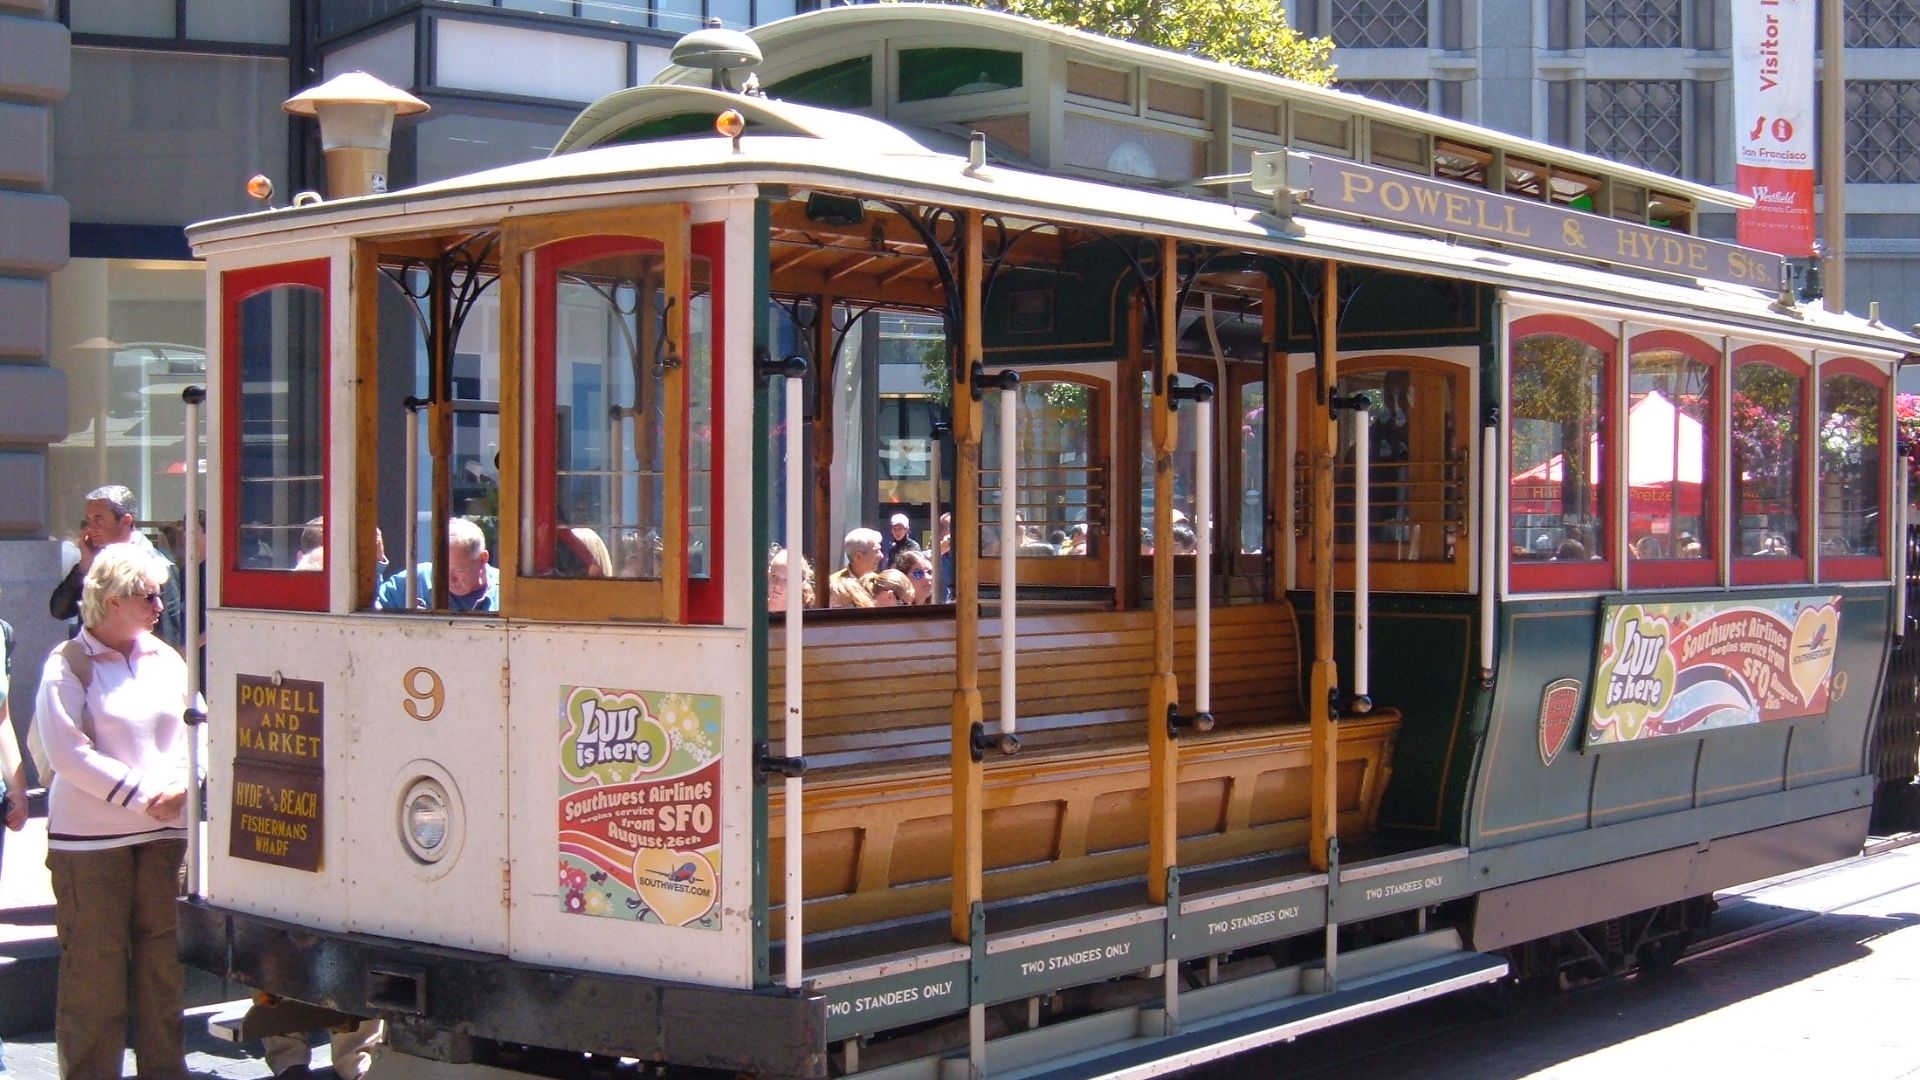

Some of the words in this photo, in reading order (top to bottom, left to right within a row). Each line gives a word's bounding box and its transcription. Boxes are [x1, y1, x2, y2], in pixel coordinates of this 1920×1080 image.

[1760, 14, 1778, 92] Visitor
[1741, 146, 1757, 158] San
[1759, 148, 1807, 160] Francisco
[1752, 186, 1797, 204] Westfield
[1340, 171, 1531, 238] POWELL
[1562, 218, 1587, 249] &
[1616, 229, 1708, 271] HYDE
[1727, 252, 1771, 283] Sts.
[1630, 487, 1674, 501] Pretze
[1682, 618, 1747, 663] Southwest
[1748, 617, 1788, 650] Airlines
[1711, 641, 1738, 656] begins
[1739, 640, 1767, 659] service
[1767, 644, 1785, 673] from
[1606, 675, 1623, 707] is
[1621, 675, 1662, 706] here
[1742, 657, 1770, 698] SFO
[1831, 671, 1848, 702] 9
[241, 685, 319, 714] POWELL
[403, 666, 446, 721] 9
[261, 713, 300, 731] AND
[239, 728, 321, 758] MARKET
[576, 743, 596, 768] is
[597, 742, 652, 766] here
[236, 782, 264, 809] HYDE
[280, 788, 317, 818] BEACH
[565, 789, 645, 821] Southwest
[649, 781, 713, 802] Airlines
[580, 812, 613, 824] begins
[615, 805, 655, 817] service
[241, 814, 308, 841] FISHERMANS
[622, 817, 656, 832] from
[658, 804, 713, 834] SFO
[255, 835, 289, 857] WHARF
[608, 821, 664, 848] August
[667, 835, 702, 848] 26th
[639, 875, 711, 898] SOUTHWEST.COM
[1366, 888, 1383, 901] TWO
[1384, 880, 1423, 897] STANDEES
[1424, 875, 1443, 889] ONLY
[1208, 920, 1229, 935] TWO
[1231, 910, 1275, 931] STANDEES
[1278, 906, 1300, 920] ONLY
[1021, 960, 1046, 976] TWO
[1048, 948, 1102, 970] STANDEES
[1105, 943, 1131, 958] ONLY
[826, 1001, 851, 1018] TWO
[855, 987, 919, 1012] STANDEES
[923, 981, 953, 999] ONLY
